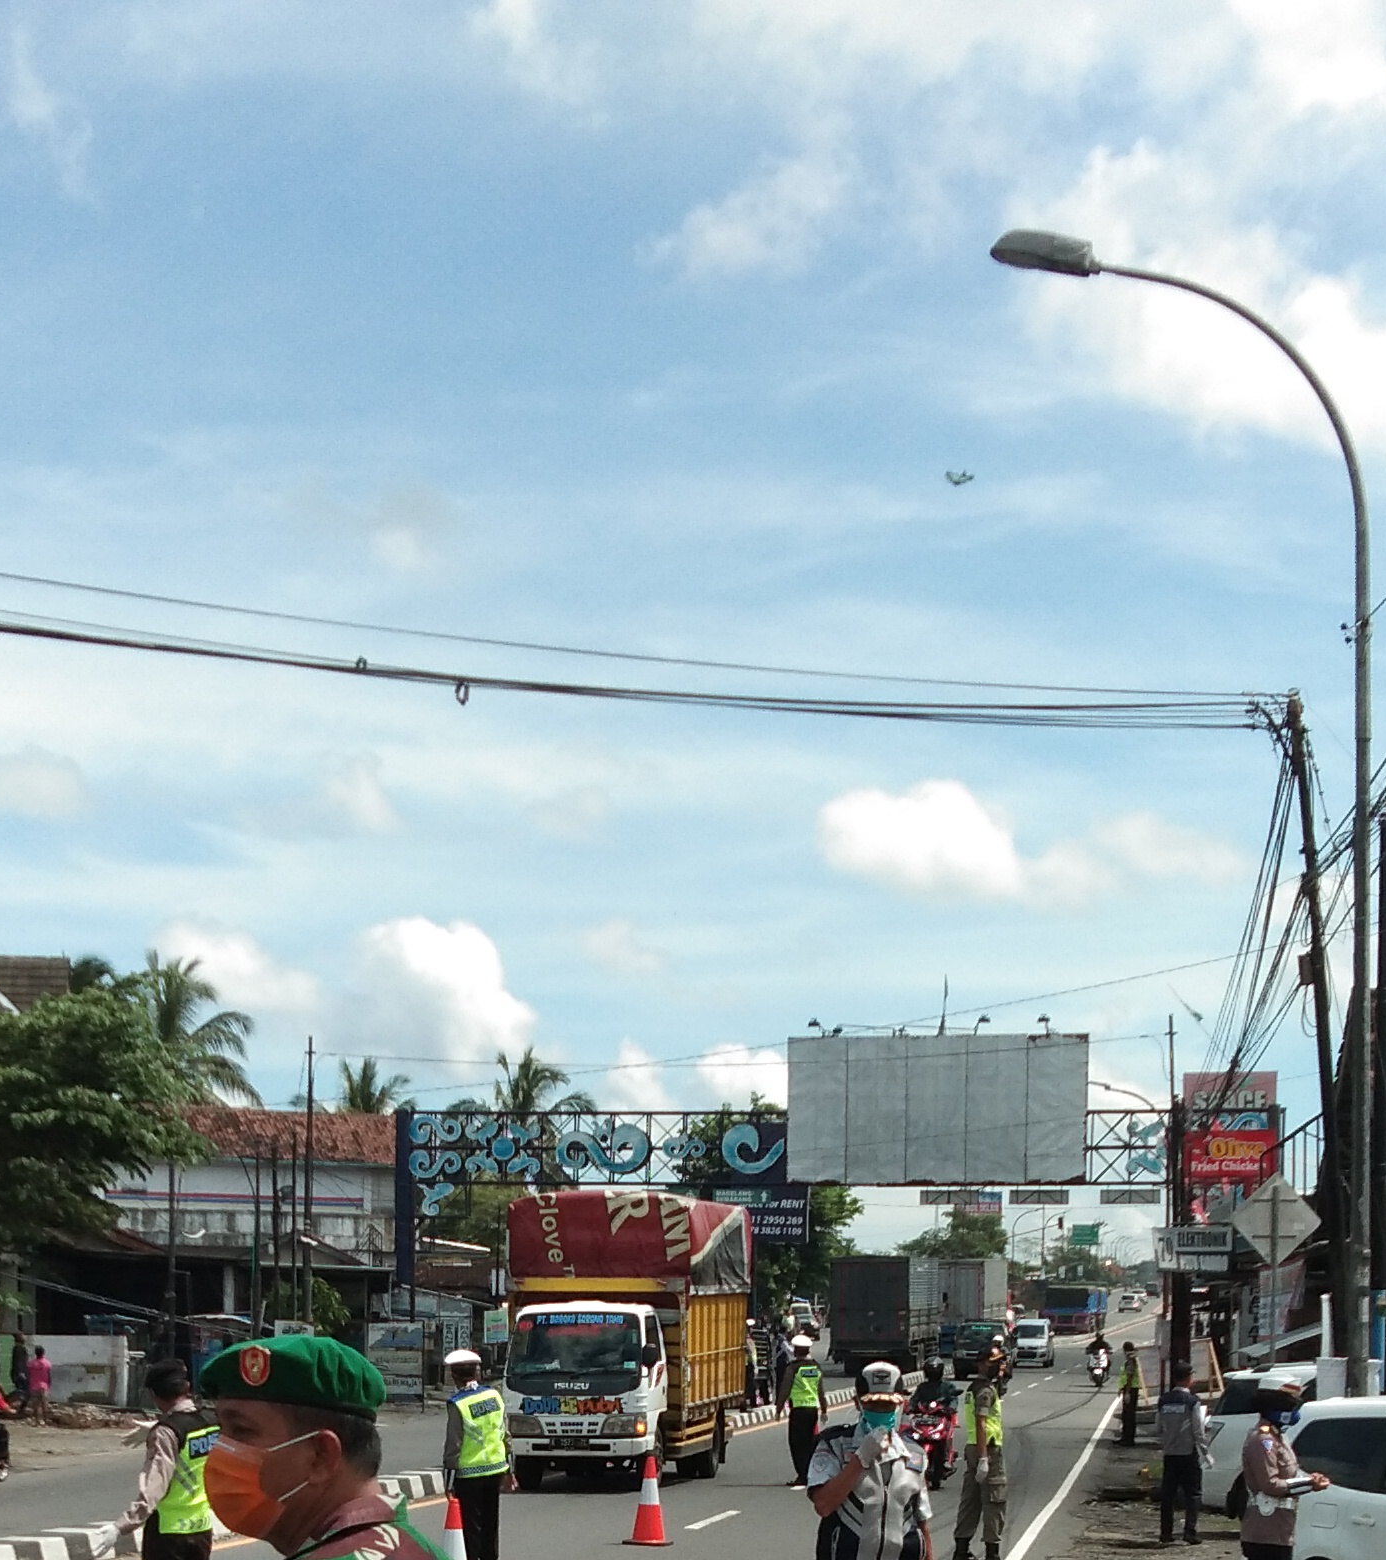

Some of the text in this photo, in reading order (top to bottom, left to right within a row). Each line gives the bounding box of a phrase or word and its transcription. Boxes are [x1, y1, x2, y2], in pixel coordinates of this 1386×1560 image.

[1209, 1137, 1266, 1159] Olive
[1191, 1160, 1219, 1172] Fried
[780, 1199, 805, 1209] RENT
[763, 1215, 785, 1225] 2950
[535, 1193, 564, 1264] Clove
[554, 1382, 589, 1390] ISUZU
